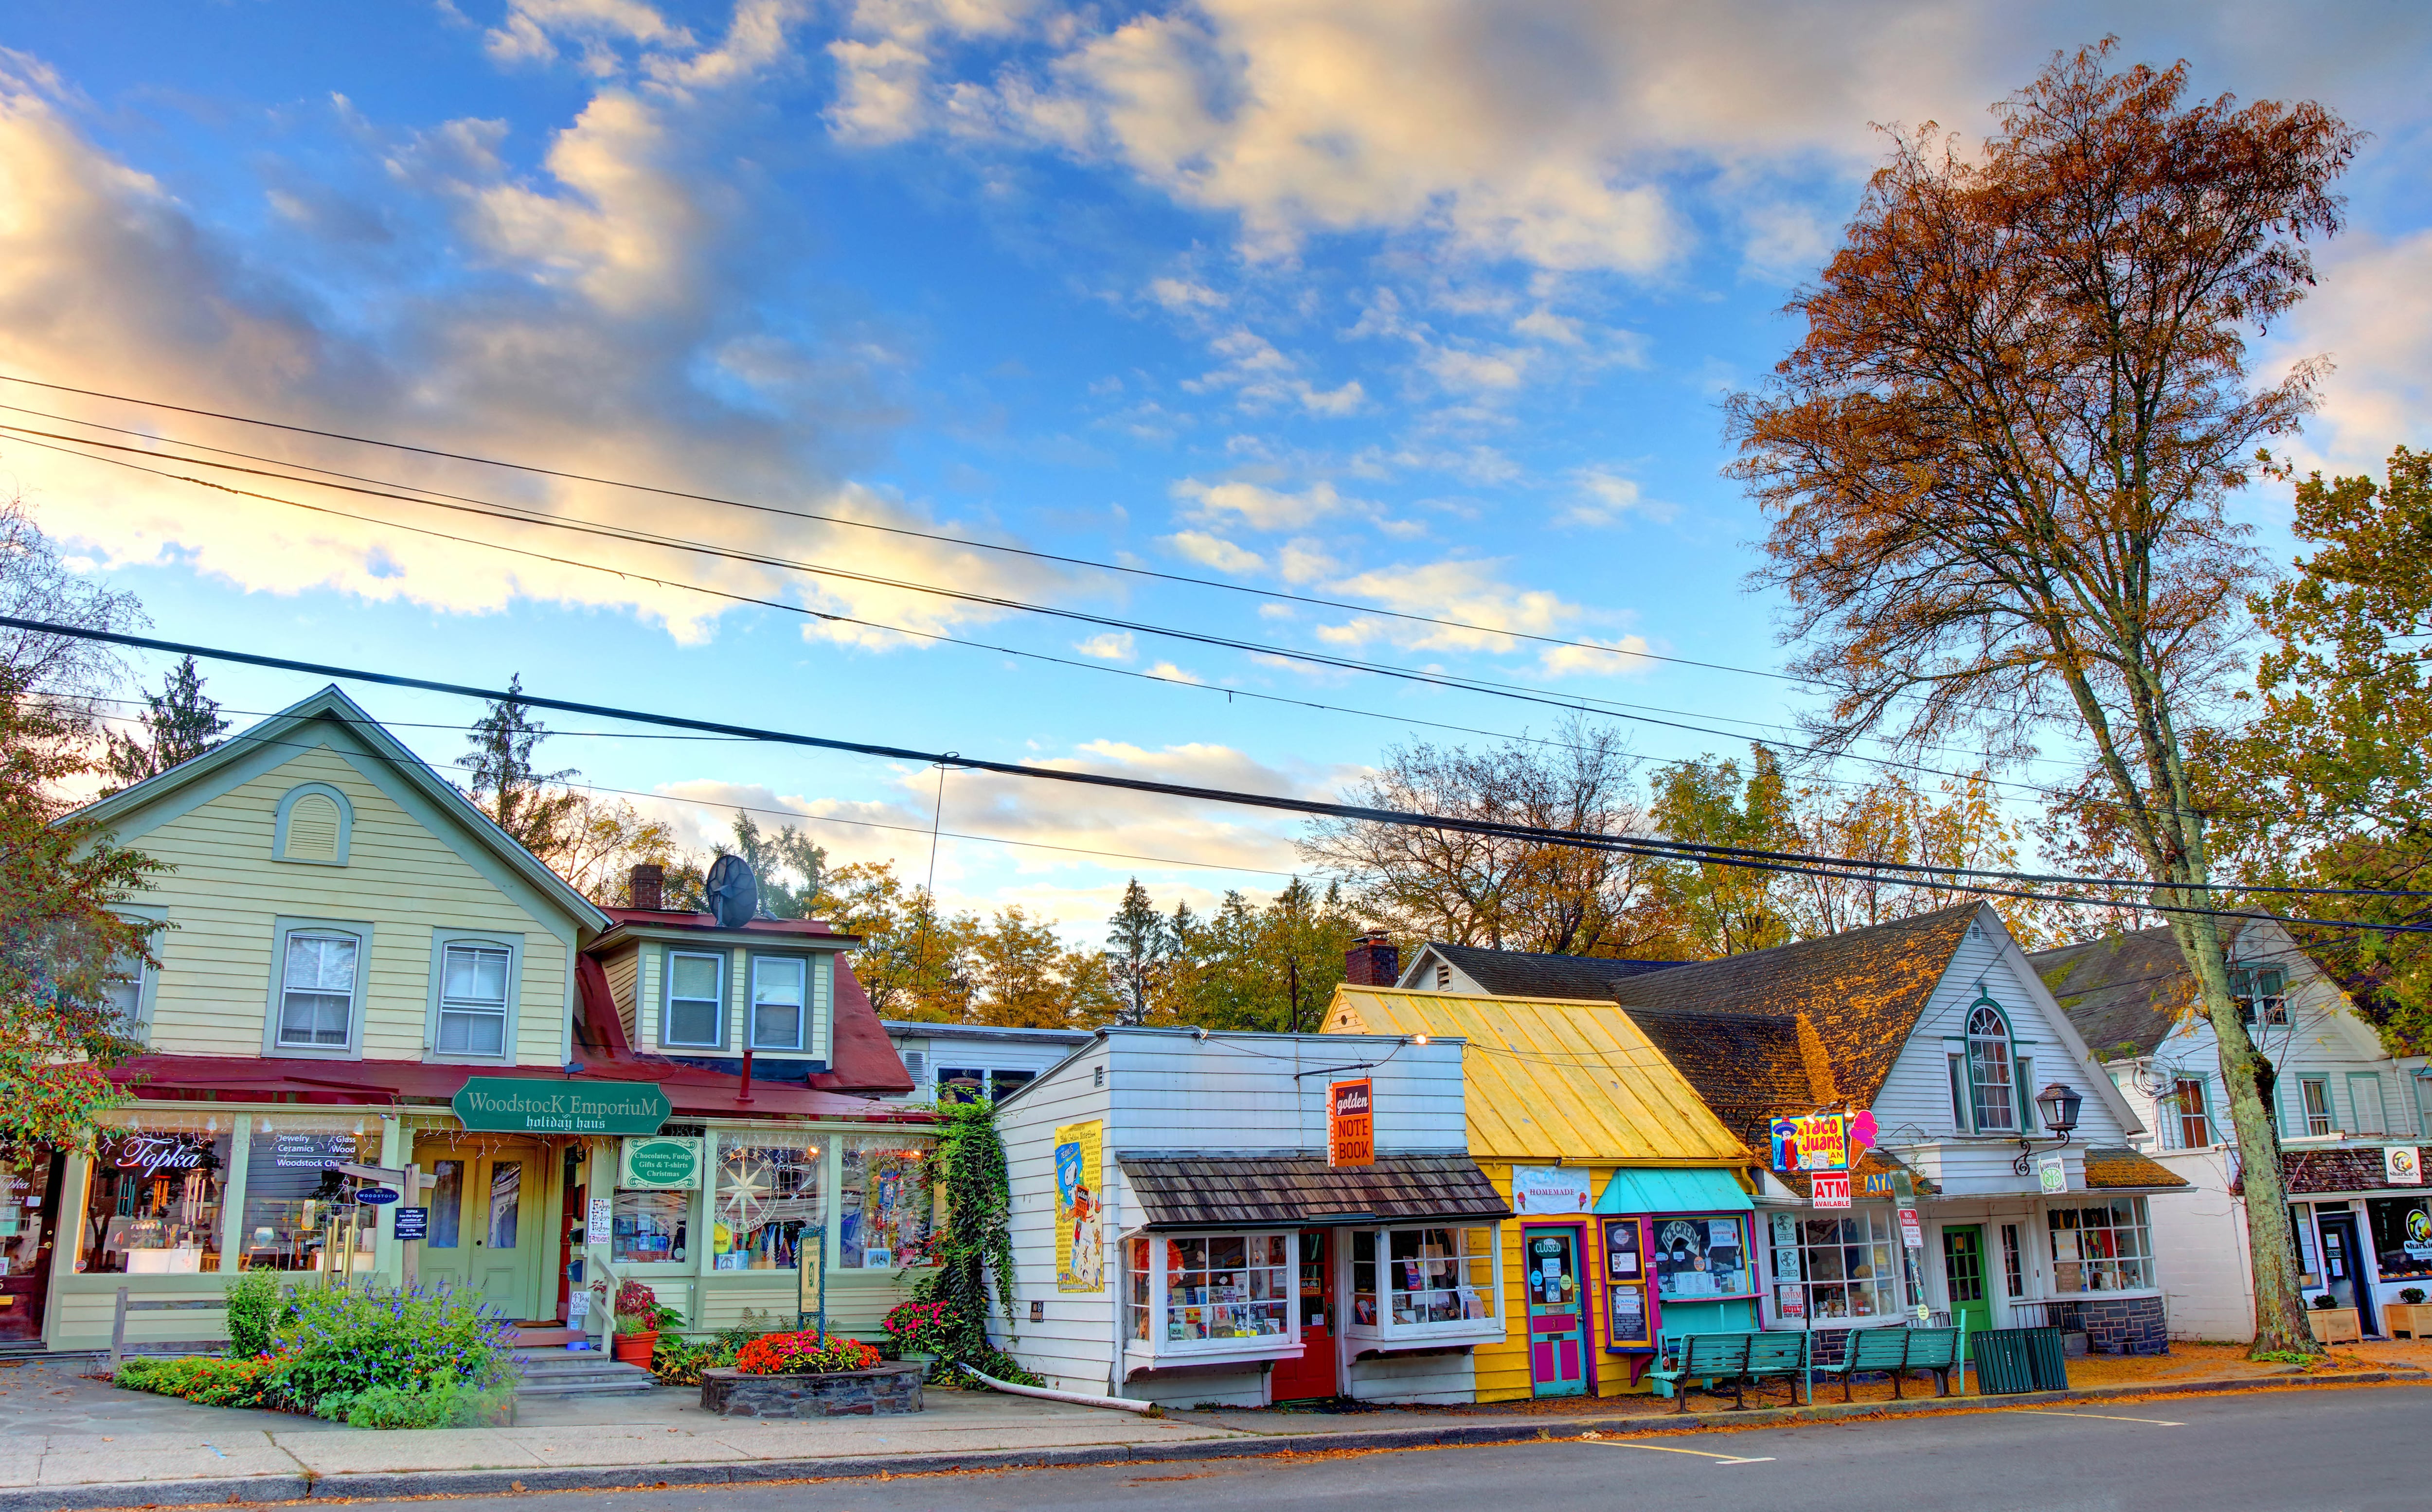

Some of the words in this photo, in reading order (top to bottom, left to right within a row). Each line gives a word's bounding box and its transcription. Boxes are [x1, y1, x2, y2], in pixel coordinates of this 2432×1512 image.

[1337, 1091, 1368, 1115] golden
[526, 1114, 572, 1130] holiday
[576, 1116, 606, 1130] haus
[1338, 1119, 1368, 1137] NOTE
[1804, 1119, 1838, 1135] Taco
[279, 1135, 310, 1143] Jewelry
[1802, 1134, 1843, 1151] Juan's
[116, 1137, 202, 1178] Topka
[1061, 1144, 1073, 1160] PEANUTS
[1339, 1141, 1369, 1159] BOOK
[1515, 1166, 1530, 1179] Serving
[1814, 1181, 1849, 1198] ATM
[592, 1199, 610, 1211] Fudge
[1076, 1199, 1086, 1210] NOTE
[1663, 1223, 1677, 1248] ICE
[1674, 1222, 1700, 1250] CREAM
[1536, 1243, 1561, 1253] CLOSED
